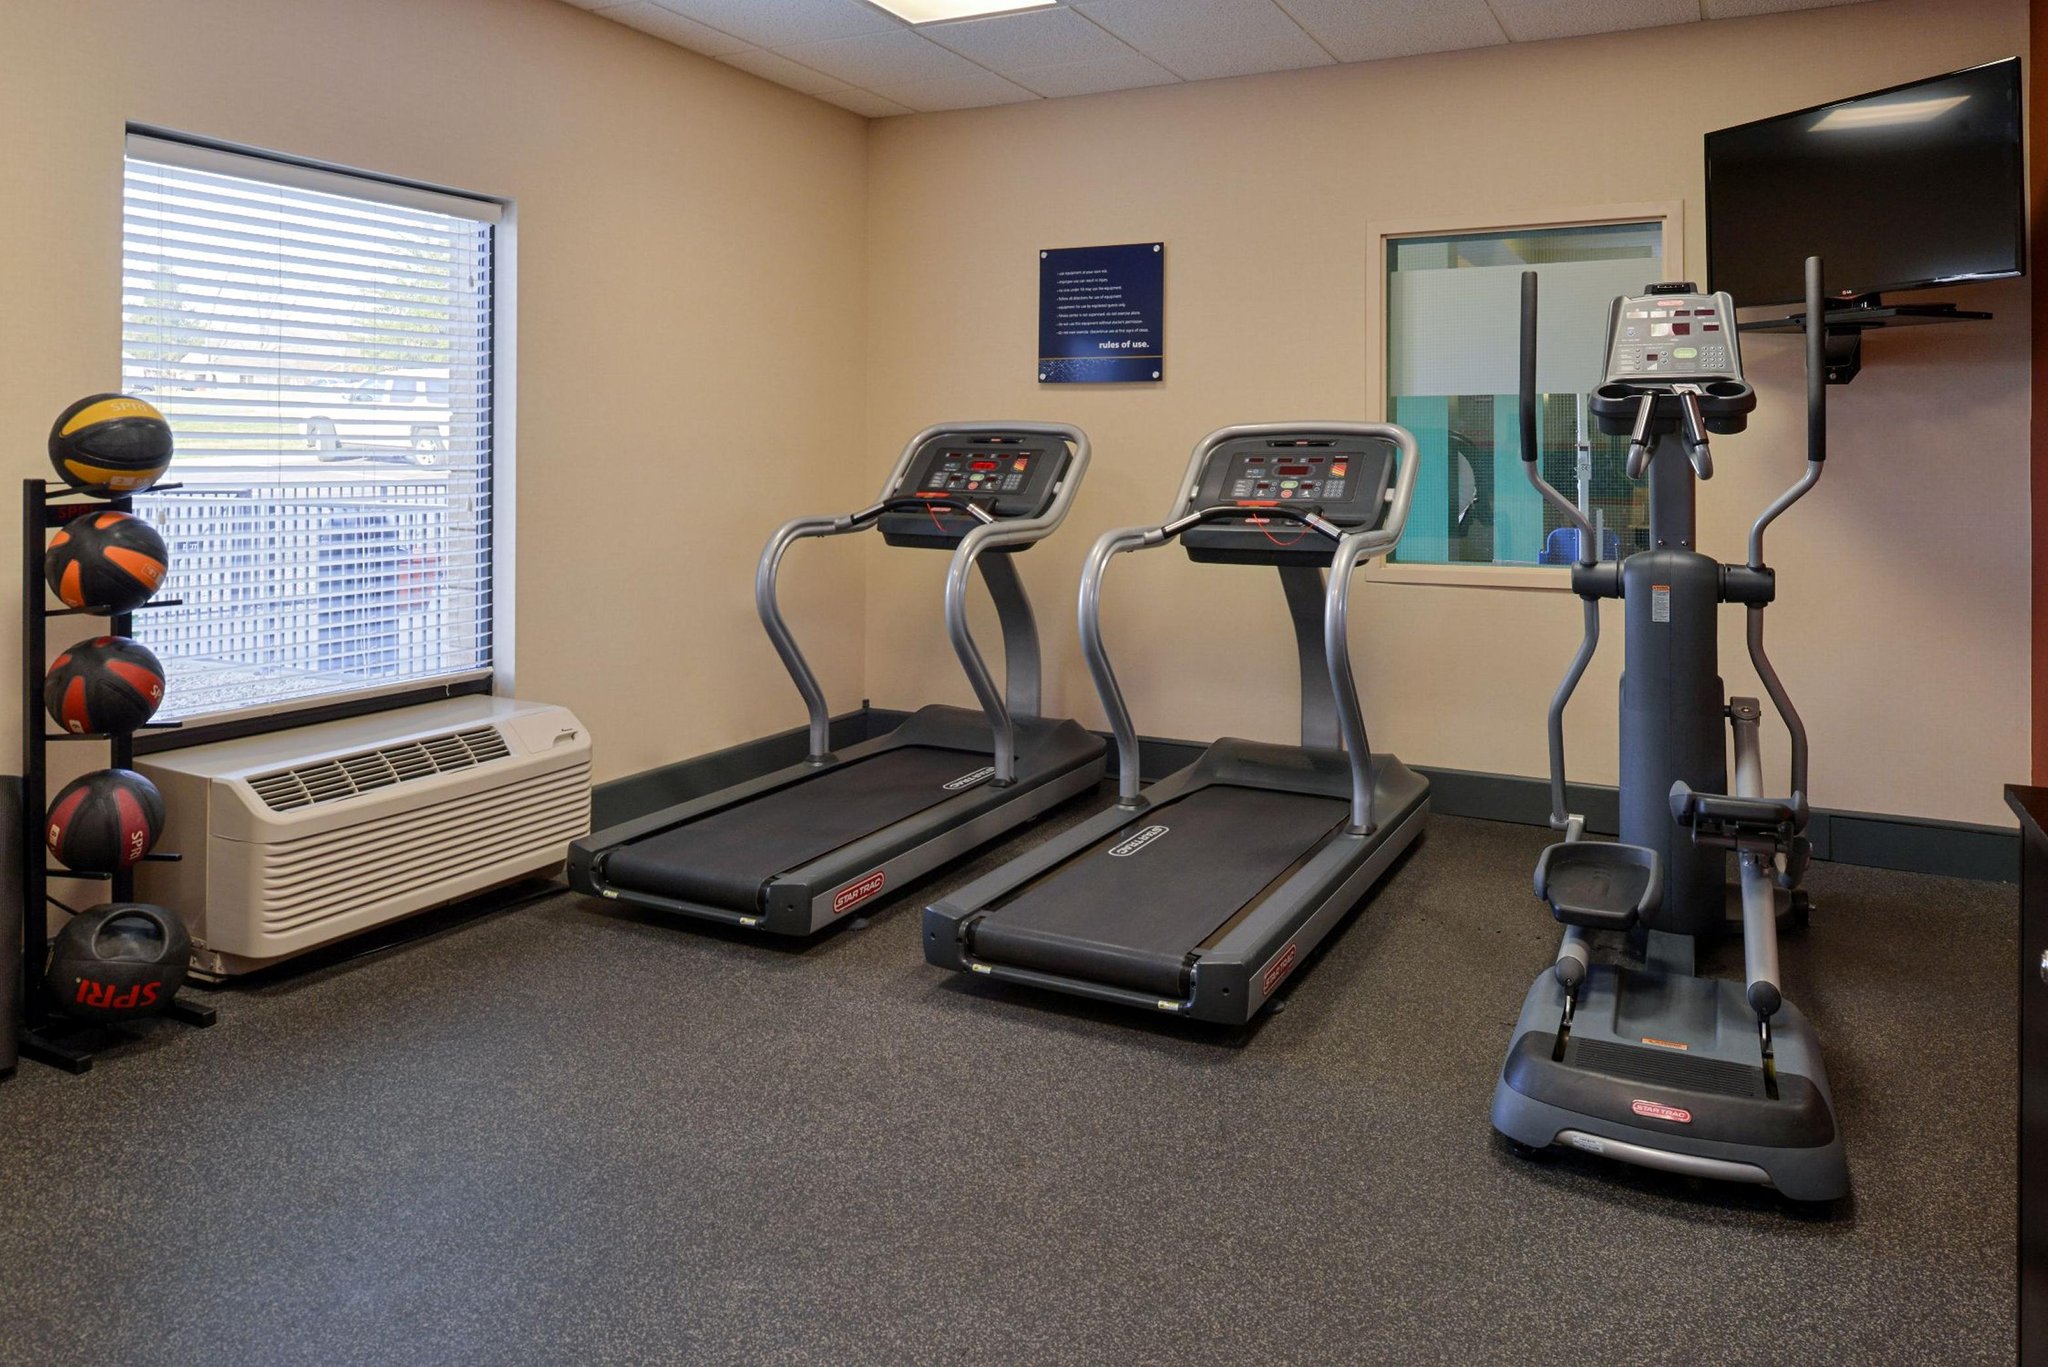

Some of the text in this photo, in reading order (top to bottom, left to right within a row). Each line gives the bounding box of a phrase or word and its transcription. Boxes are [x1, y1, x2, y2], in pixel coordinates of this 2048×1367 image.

[1099, 341, 1120, 349] rules
[1121, 340, 1131, 348] of
[129, 830, 143, 860] SPRI
[836, 877, 881, 907] STAR TRAC
[1636, 1104, 1685, 1118] STAR TRAC
